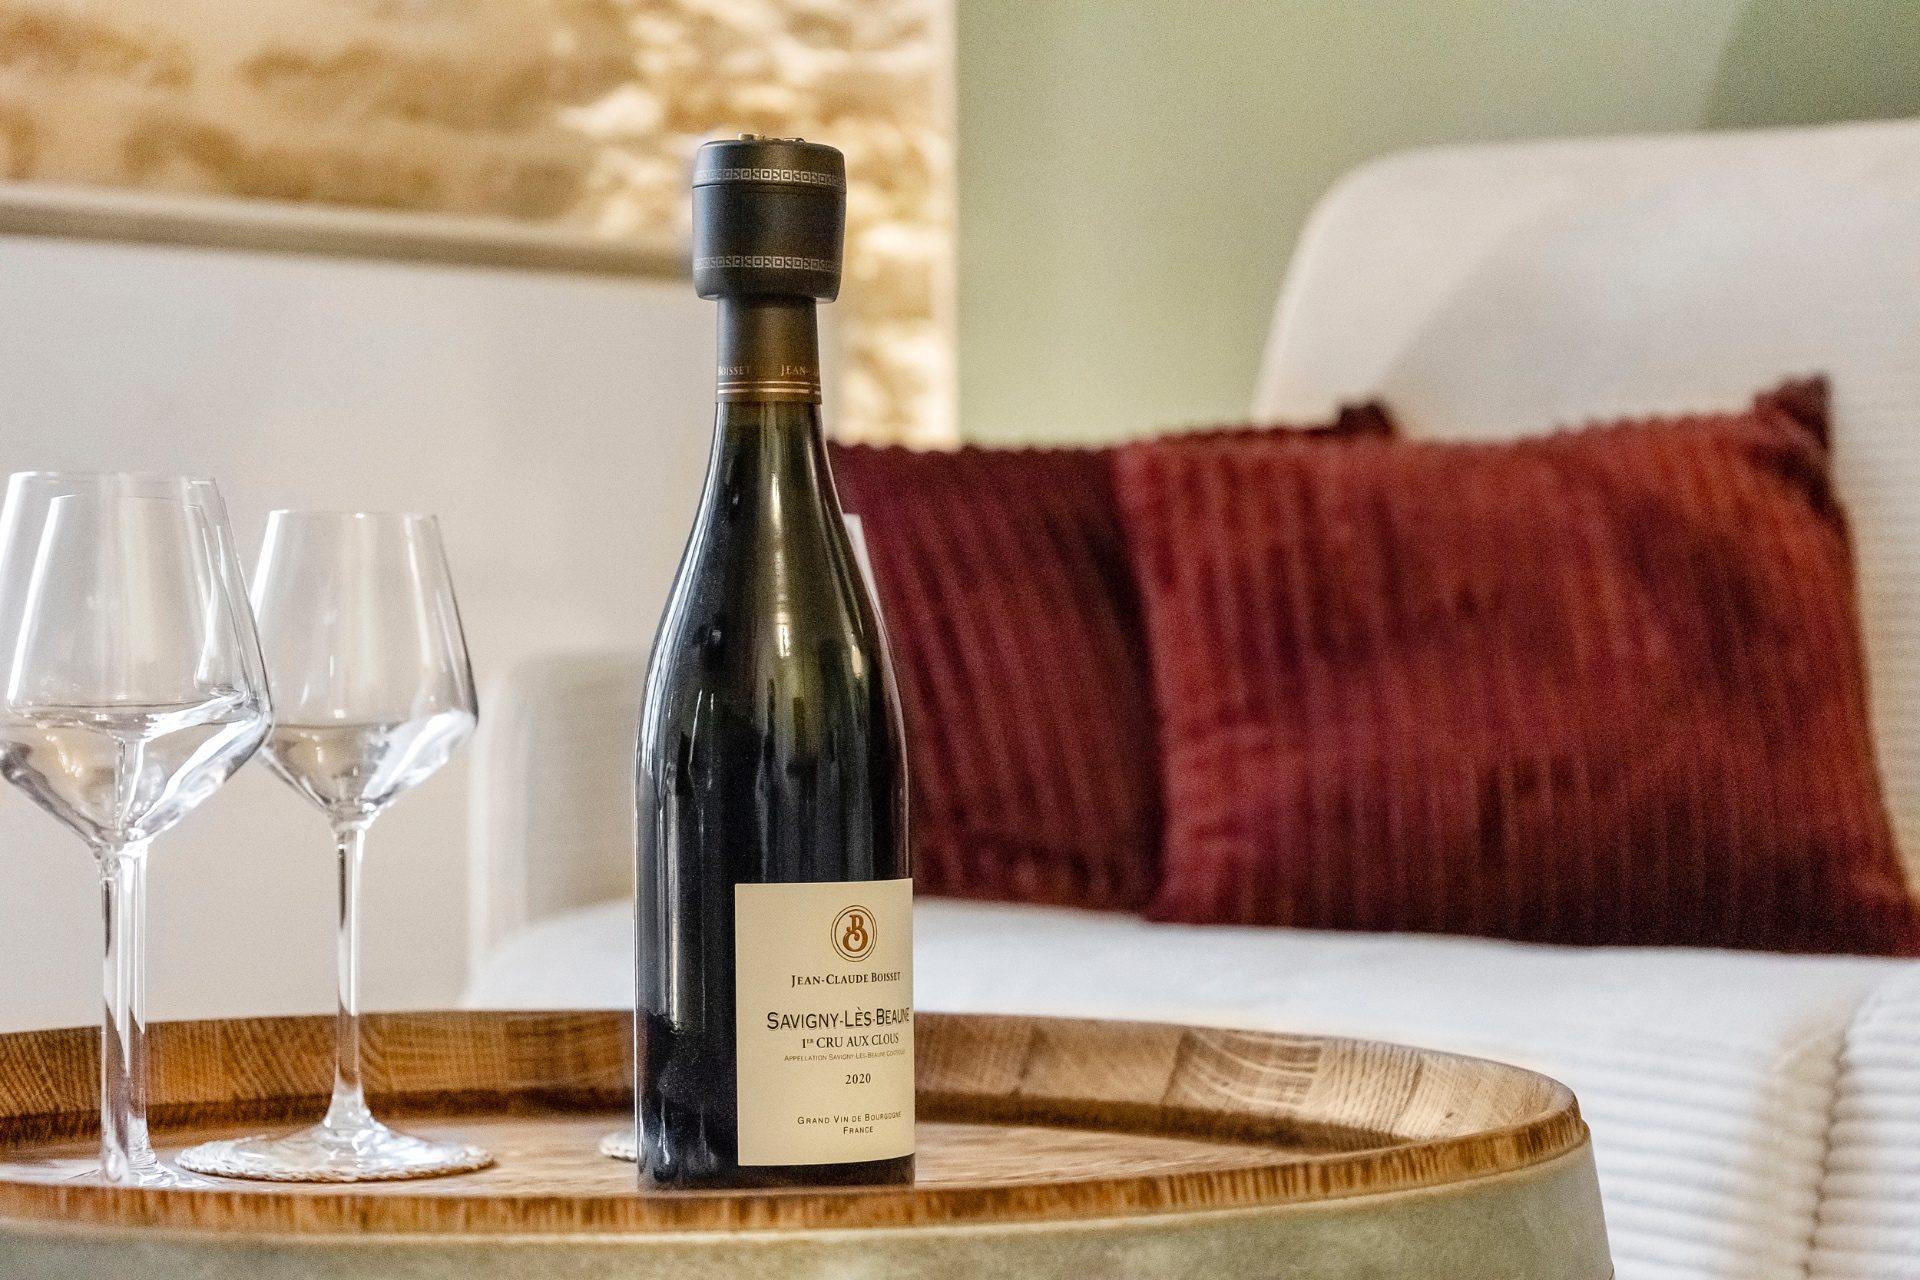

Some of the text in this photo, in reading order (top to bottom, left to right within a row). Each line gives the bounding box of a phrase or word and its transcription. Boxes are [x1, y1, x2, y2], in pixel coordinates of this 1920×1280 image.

[791, 971, 901, 988] JEAN-CLAUDE BOISSET
[767, 1006, 910, 1030] SAVIGNY-LÈS-BEAUNE
[816, 1036, 844, 1049] CRU
[846, 1034, 869, 1048] AUX
[871, 1032, 899, 1046] CLOUS
[784, 1054, 827, 1062] APPELLATION
[845, 1072, 872, 1085] 2020
[797, 1111, 902, 1125] GRAND VIN DE BOURGOGNE
[843, 1126, 874, 1135] FRANCE
